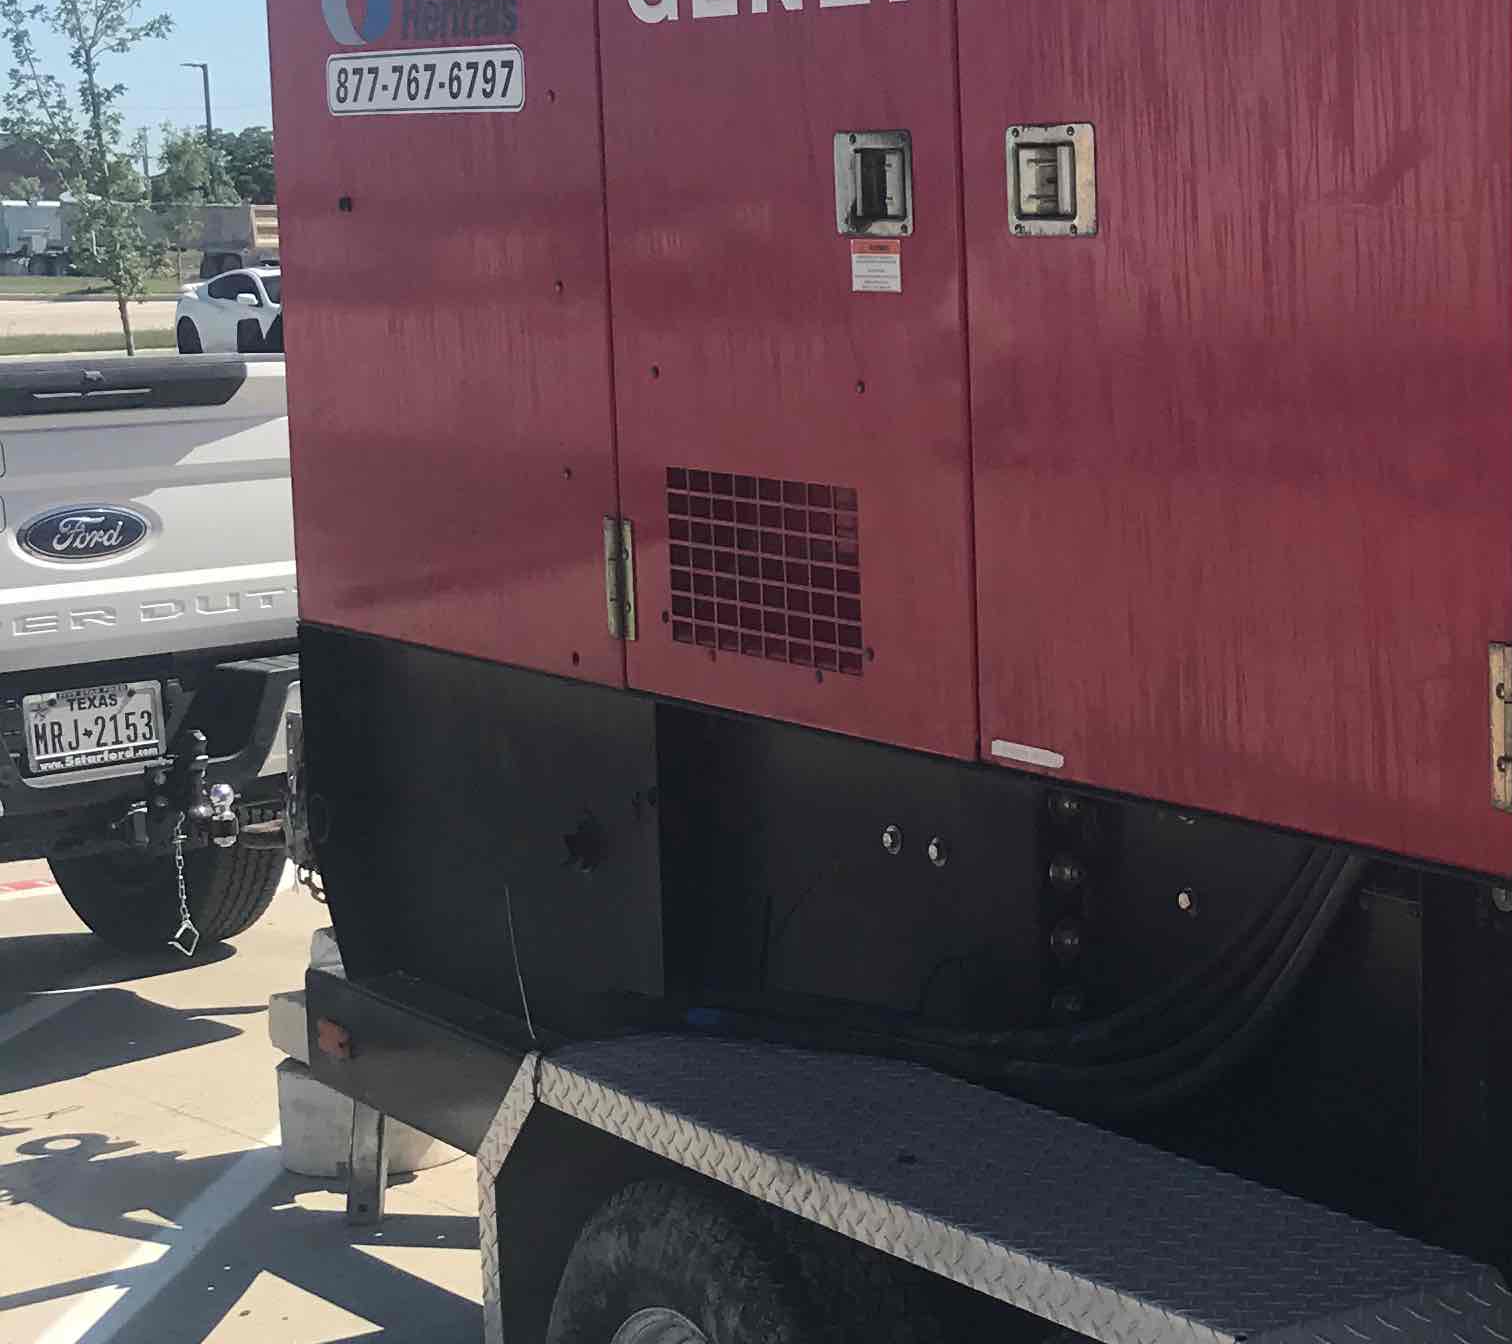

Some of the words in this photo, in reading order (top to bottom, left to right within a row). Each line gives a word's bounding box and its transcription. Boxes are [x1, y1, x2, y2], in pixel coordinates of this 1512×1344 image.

[336, 59, 514, 104] 877-767-6797
[52, 514, 123, 551] Ford
[0, 608, 116, 636] ER
[140, 587, 297, 622] DUT
[65, 692, 118, 712] TEXAS
